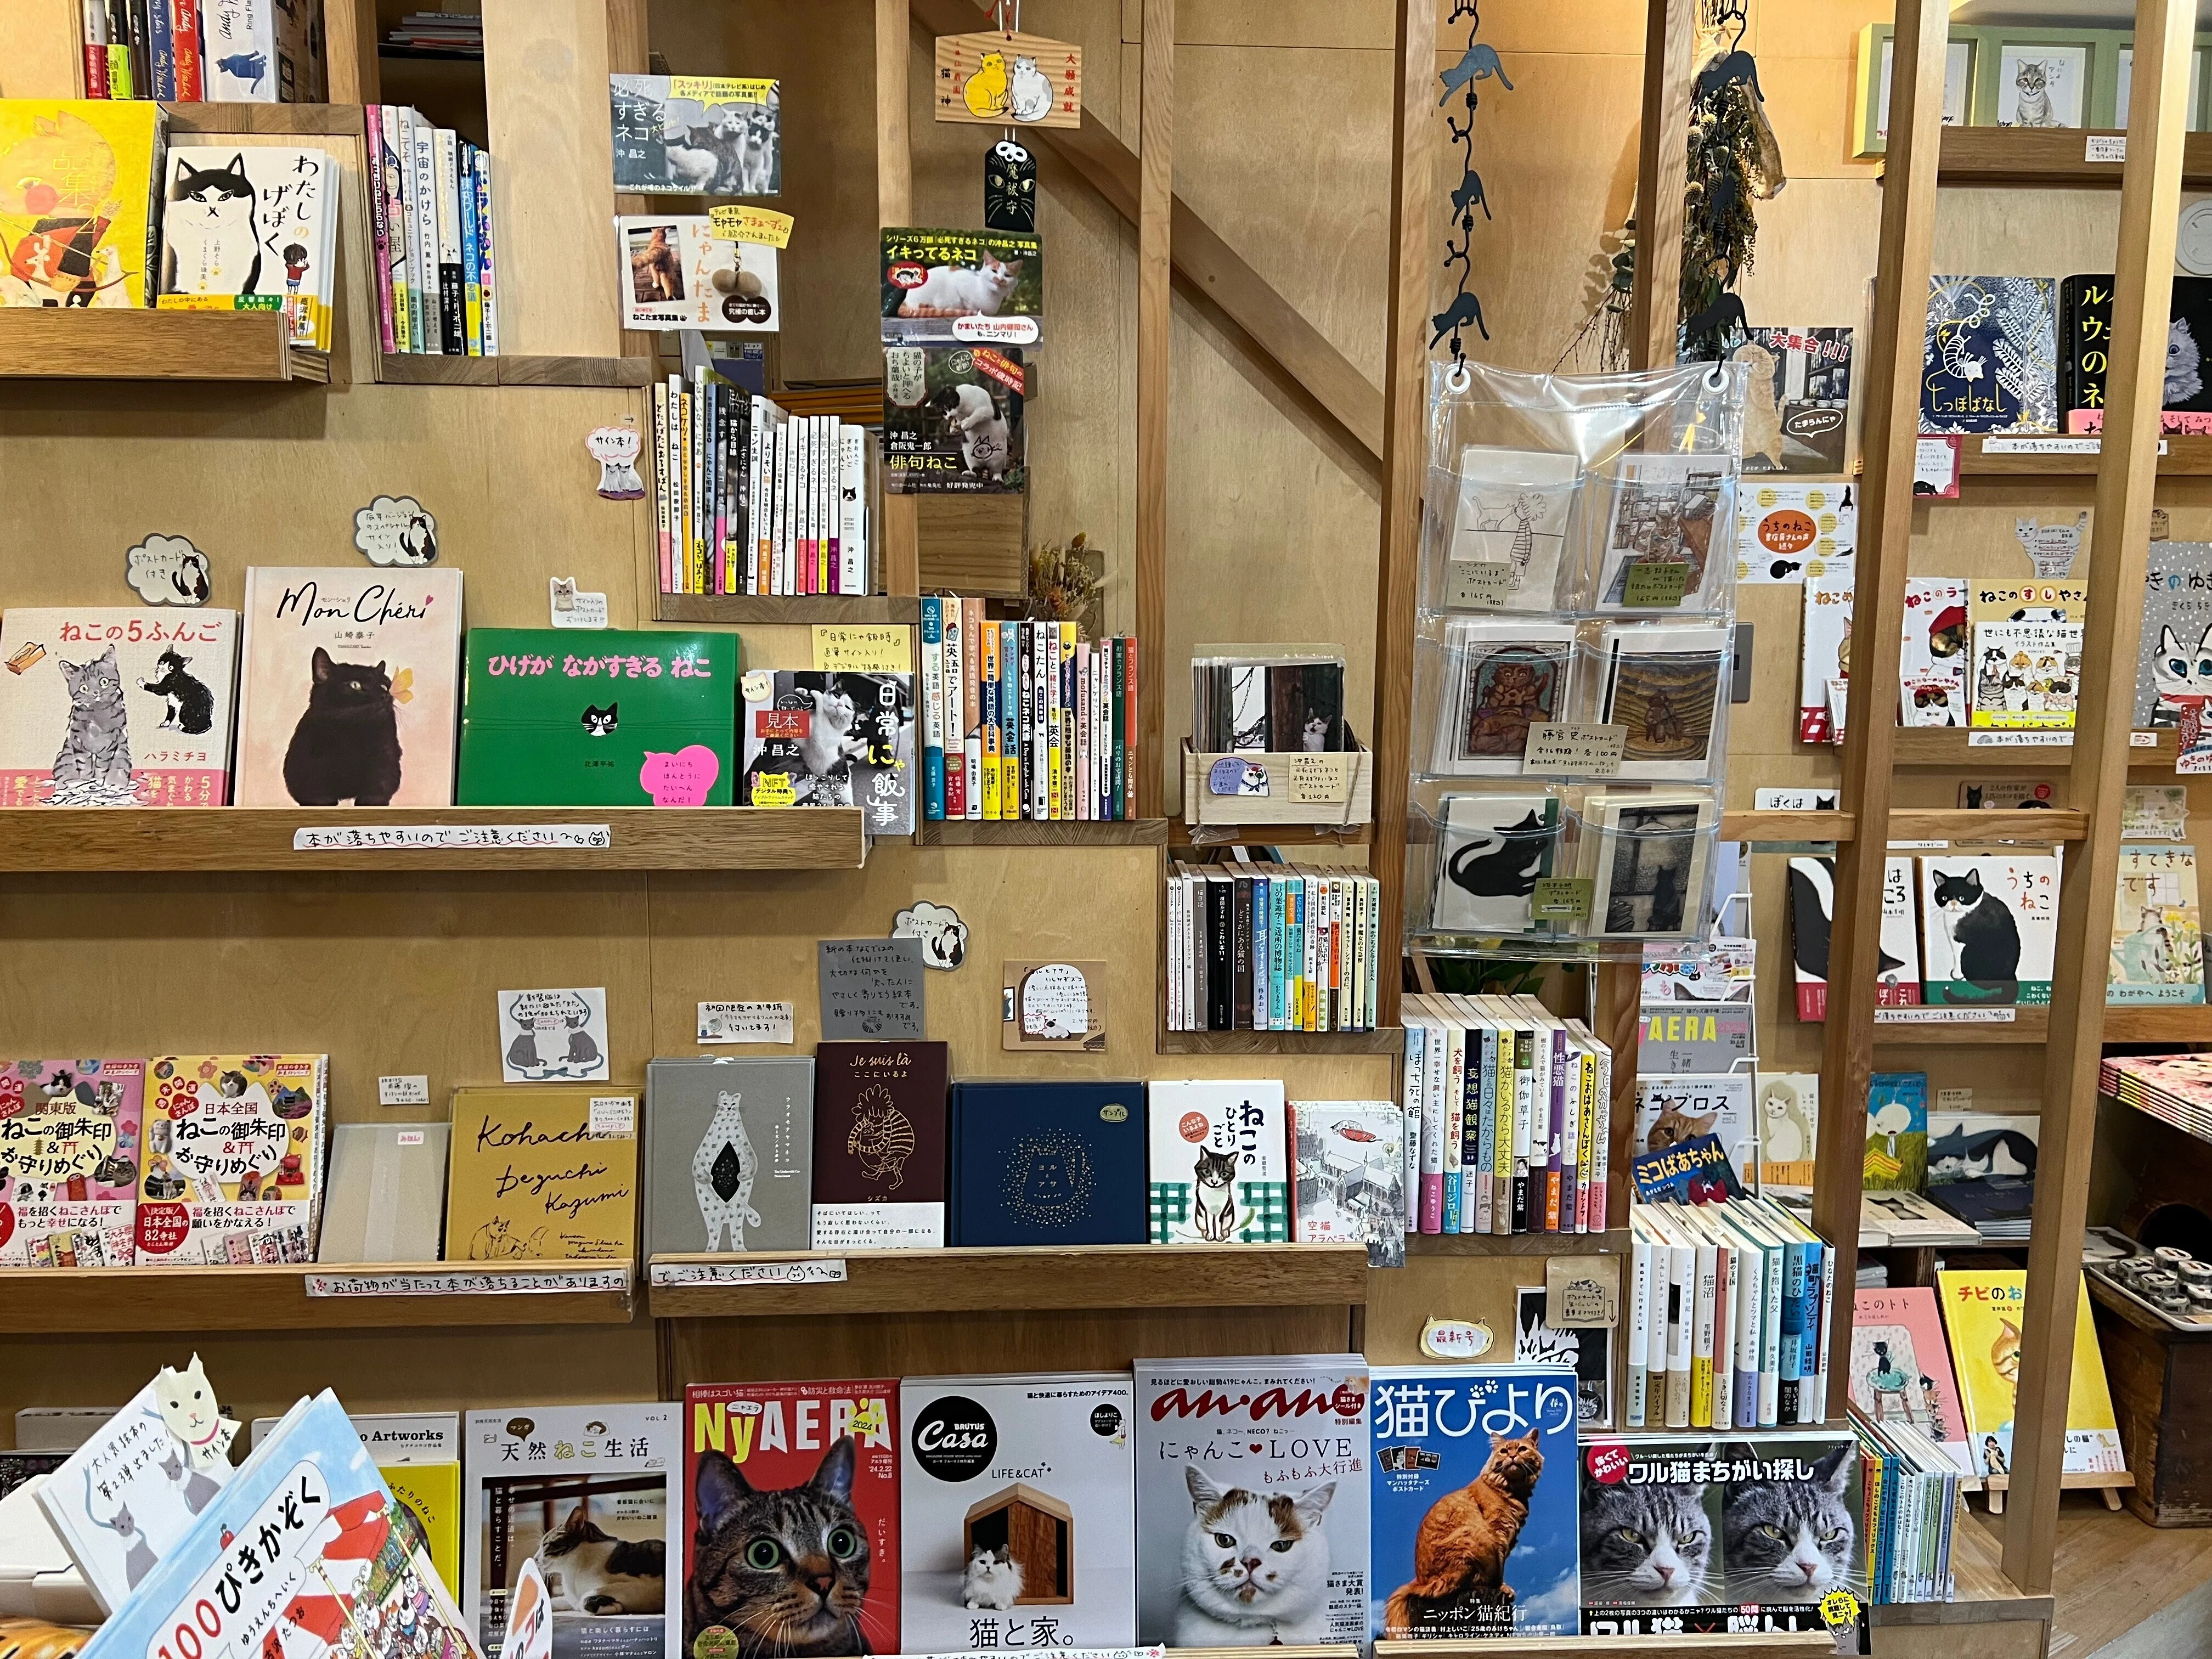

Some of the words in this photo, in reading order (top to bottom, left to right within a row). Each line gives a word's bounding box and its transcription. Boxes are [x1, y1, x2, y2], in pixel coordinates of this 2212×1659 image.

[614, 102, 665, 121] すぎる
[616, 125, 649, 142] ネコ
[417, 141, 432, 226] 宇宙のかけら
[291, 154, 319, 239] わたしの
[263, 184, 292, 256] げぼく
[886, 246, 978, 262] イキってるネコ
[1932, 383, 2008, 413] しっぽばなし
[670, 390, 679, 431] わたしは
[672, 442, 679, 461] ねこ
[810, 431, 819, 493] 必死すぎるネコ
[889, 455, 958, 470] 俳句ねこ
[1763, 520, 1811, 533] うちのねこ
[275, 581, 349, 627] Mon
[354, 585, 430, 625] Chéri
[60, 622, 222, 642] ねこの5ふんご
[489, 654, 555, 676] ひげが
[562, 654, 663, 679] ながすぎる
[672, 657, 712, 679] ねこ
[1035, 630, 1046, 680] ねこたん
[766, 713, 799, 729] 見本
[145, 751, 207, 762] ハラミチヨ
[763, 778, 786, 788] NFT
[1770, 795, 1803, 809] ぼくは
[2130, 850, 2193, 869] すてきな
[2007, 867, 2050, 890] うちの
[2123, 873, 2160, 897] です
[2020, 893, 2050, 911] ねこ
[850, 1053, 867, 1068] Je
[871, 1057, 894, 1067] suis
[896, 1052, 912, 1066] là
[1452, 1048, 1463, 1085] 犬を飼う
[1552, 1052, 1565, 1087] 性悪猫
[854, 1070, 907, 1078] ここにいるよ
[36, 1102, 77, 1115] 関東版
[205, 1101, 258, 1115] 日本全国
[1431, 1039, 1442, 1164] 世界一幸せな飼い主にしてくれた猫
[1464, 1067, 1479, 1141] 妄想猫観察
[1, 1118, 112, 1141] ねこの御朱印
[176, 1118, 286, 1142] ねこの御朱印
[1225, 1107, 1235, 1147] ひとり
[1480, 1064, 1496, 1173] 猫との日々はたからもの
[1498, 1064, 1513, 1173] 猫がいるから大丈夫
[1213, 1123, 1226, 1148] ごと
[1238, 1100, 1265, 1165] ねこの
[1450, 1112, 1460, 1150] 猫を飼う
[222, 1141, 236, 1154] &
[175, 1145, 278, 1176] お守りめぐり
[1637, 1141, 1725, 1184] ミコばあちゃん
[496, 1163, 608, 1199] Deguchi
[18, 1204, 122, 1217] 福を招くねこさんぽで
[193, 1205, 296, 1217] 福を招くねこさんぽで
[545, 1183, 629, 1219] Kazumi
[143, 1215, 189, 1228] 日本全国の
[191, 1217, 272, 1229] 願いをかなえる!
[1307, 1221, 1331, 1232] 空猫
[144, 1229, 177, 1241] 82寺社
[1702, 1274, 1715, 1299] 猫沼
[1769, 1257, 1780, 1314] 猫を抱いた父
[1374, 1383, 1573, 1439] 猫びより
[852, 1419, 873, 1431] 2024
[917, 1419, 989, 1452] Casa
[954, 1423, 985, 1431] BRUTUS
[500, 1437, 650, 1462] 天然ねこ生活
[1159, 1440, 1244, 1460] にゃんこ
[1269, 1438, 1352, 1459] LOVE
[991, 1469, 1044, 1479] LIFE&CAT
[1264, 1458, 1363, 1484] もふもふ大行進
[1594, 1456, 1629, 1477] かわいい
[1628, 1458, 1814, 1483] ワル猫まちがい探し
[878, 1517, 887, 1563] だいすき。
[1327, 1578, 1363, 1588] 猫さま大賞
[1423, 1604, 1528, 1622] ニッポン猫紀行
[969, 1616, 1074, 1649] 猫と家。
